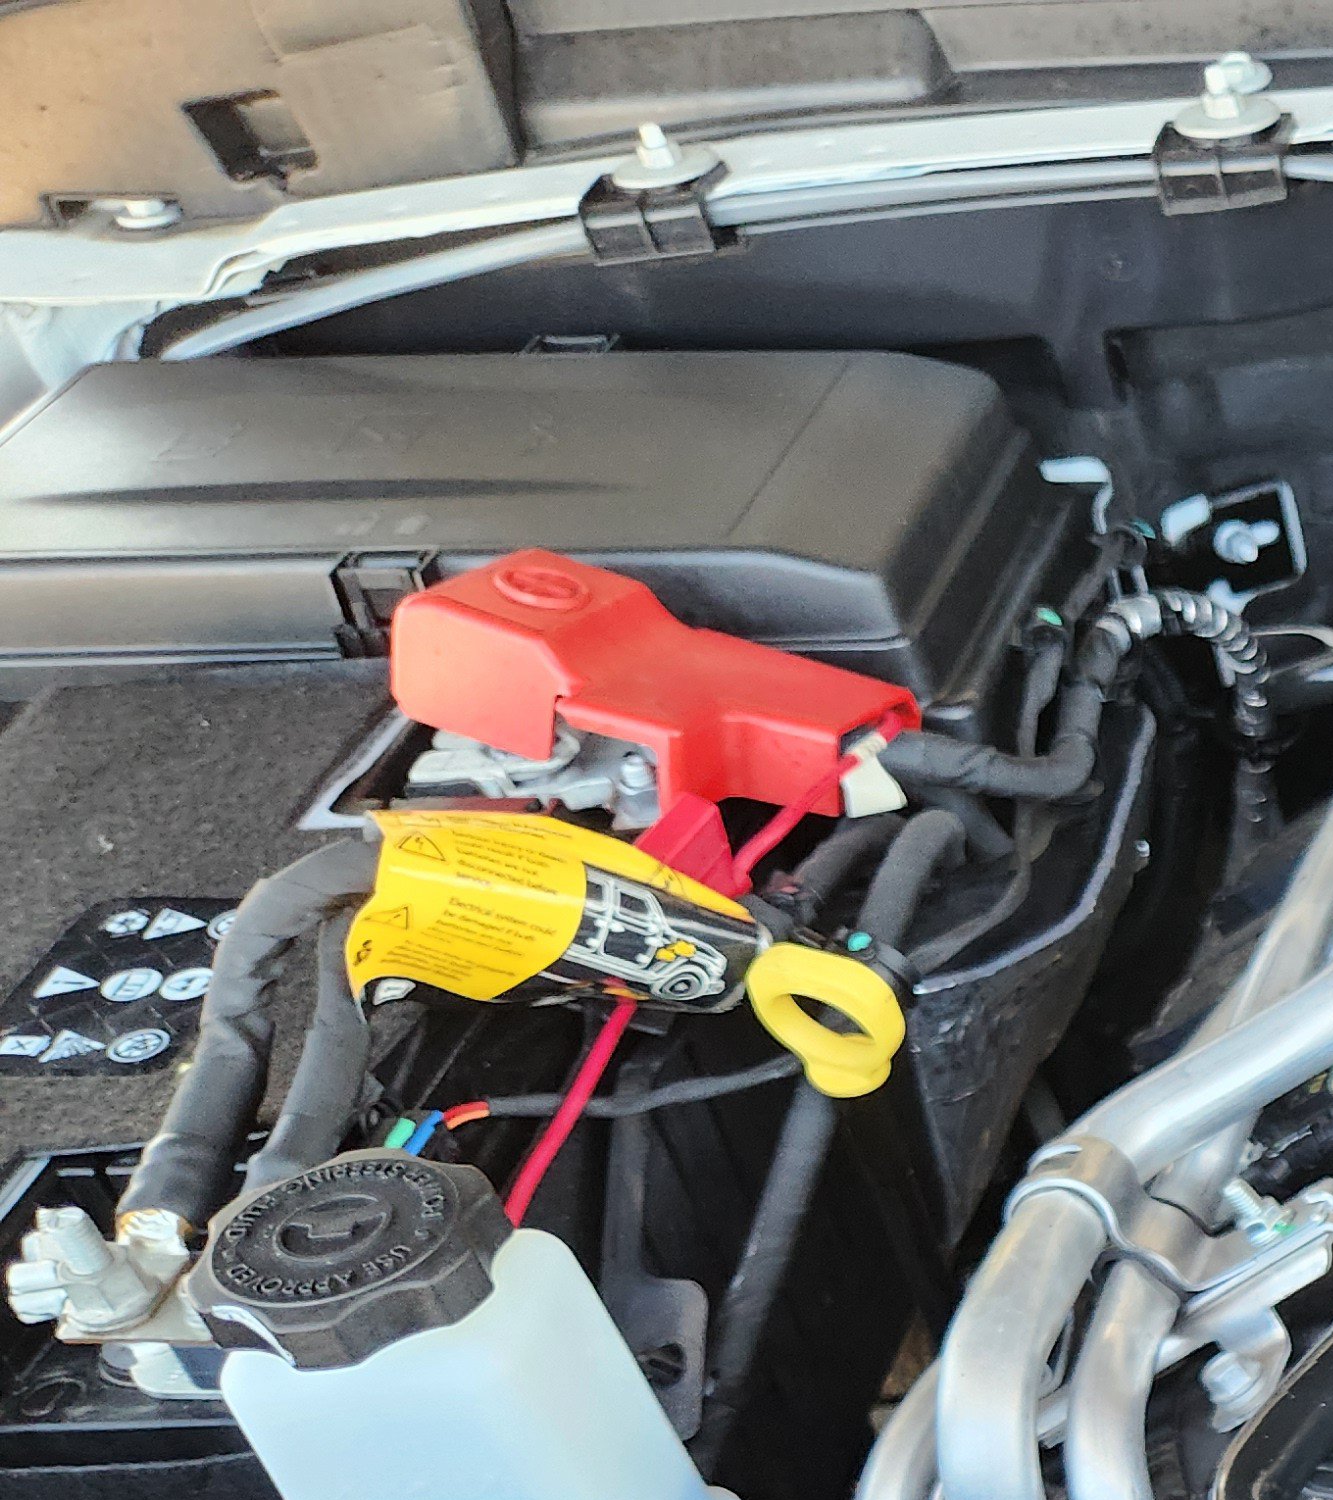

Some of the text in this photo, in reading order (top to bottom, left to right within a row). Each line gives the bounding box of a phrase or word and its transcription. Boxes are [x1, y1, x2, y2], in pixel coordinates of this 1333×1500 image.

[282, 1161, 406, 1195] STEERING
[225, 1193, 278, 1243] FLUID
[226, 1244, 413, 1296] USE APPROVED
